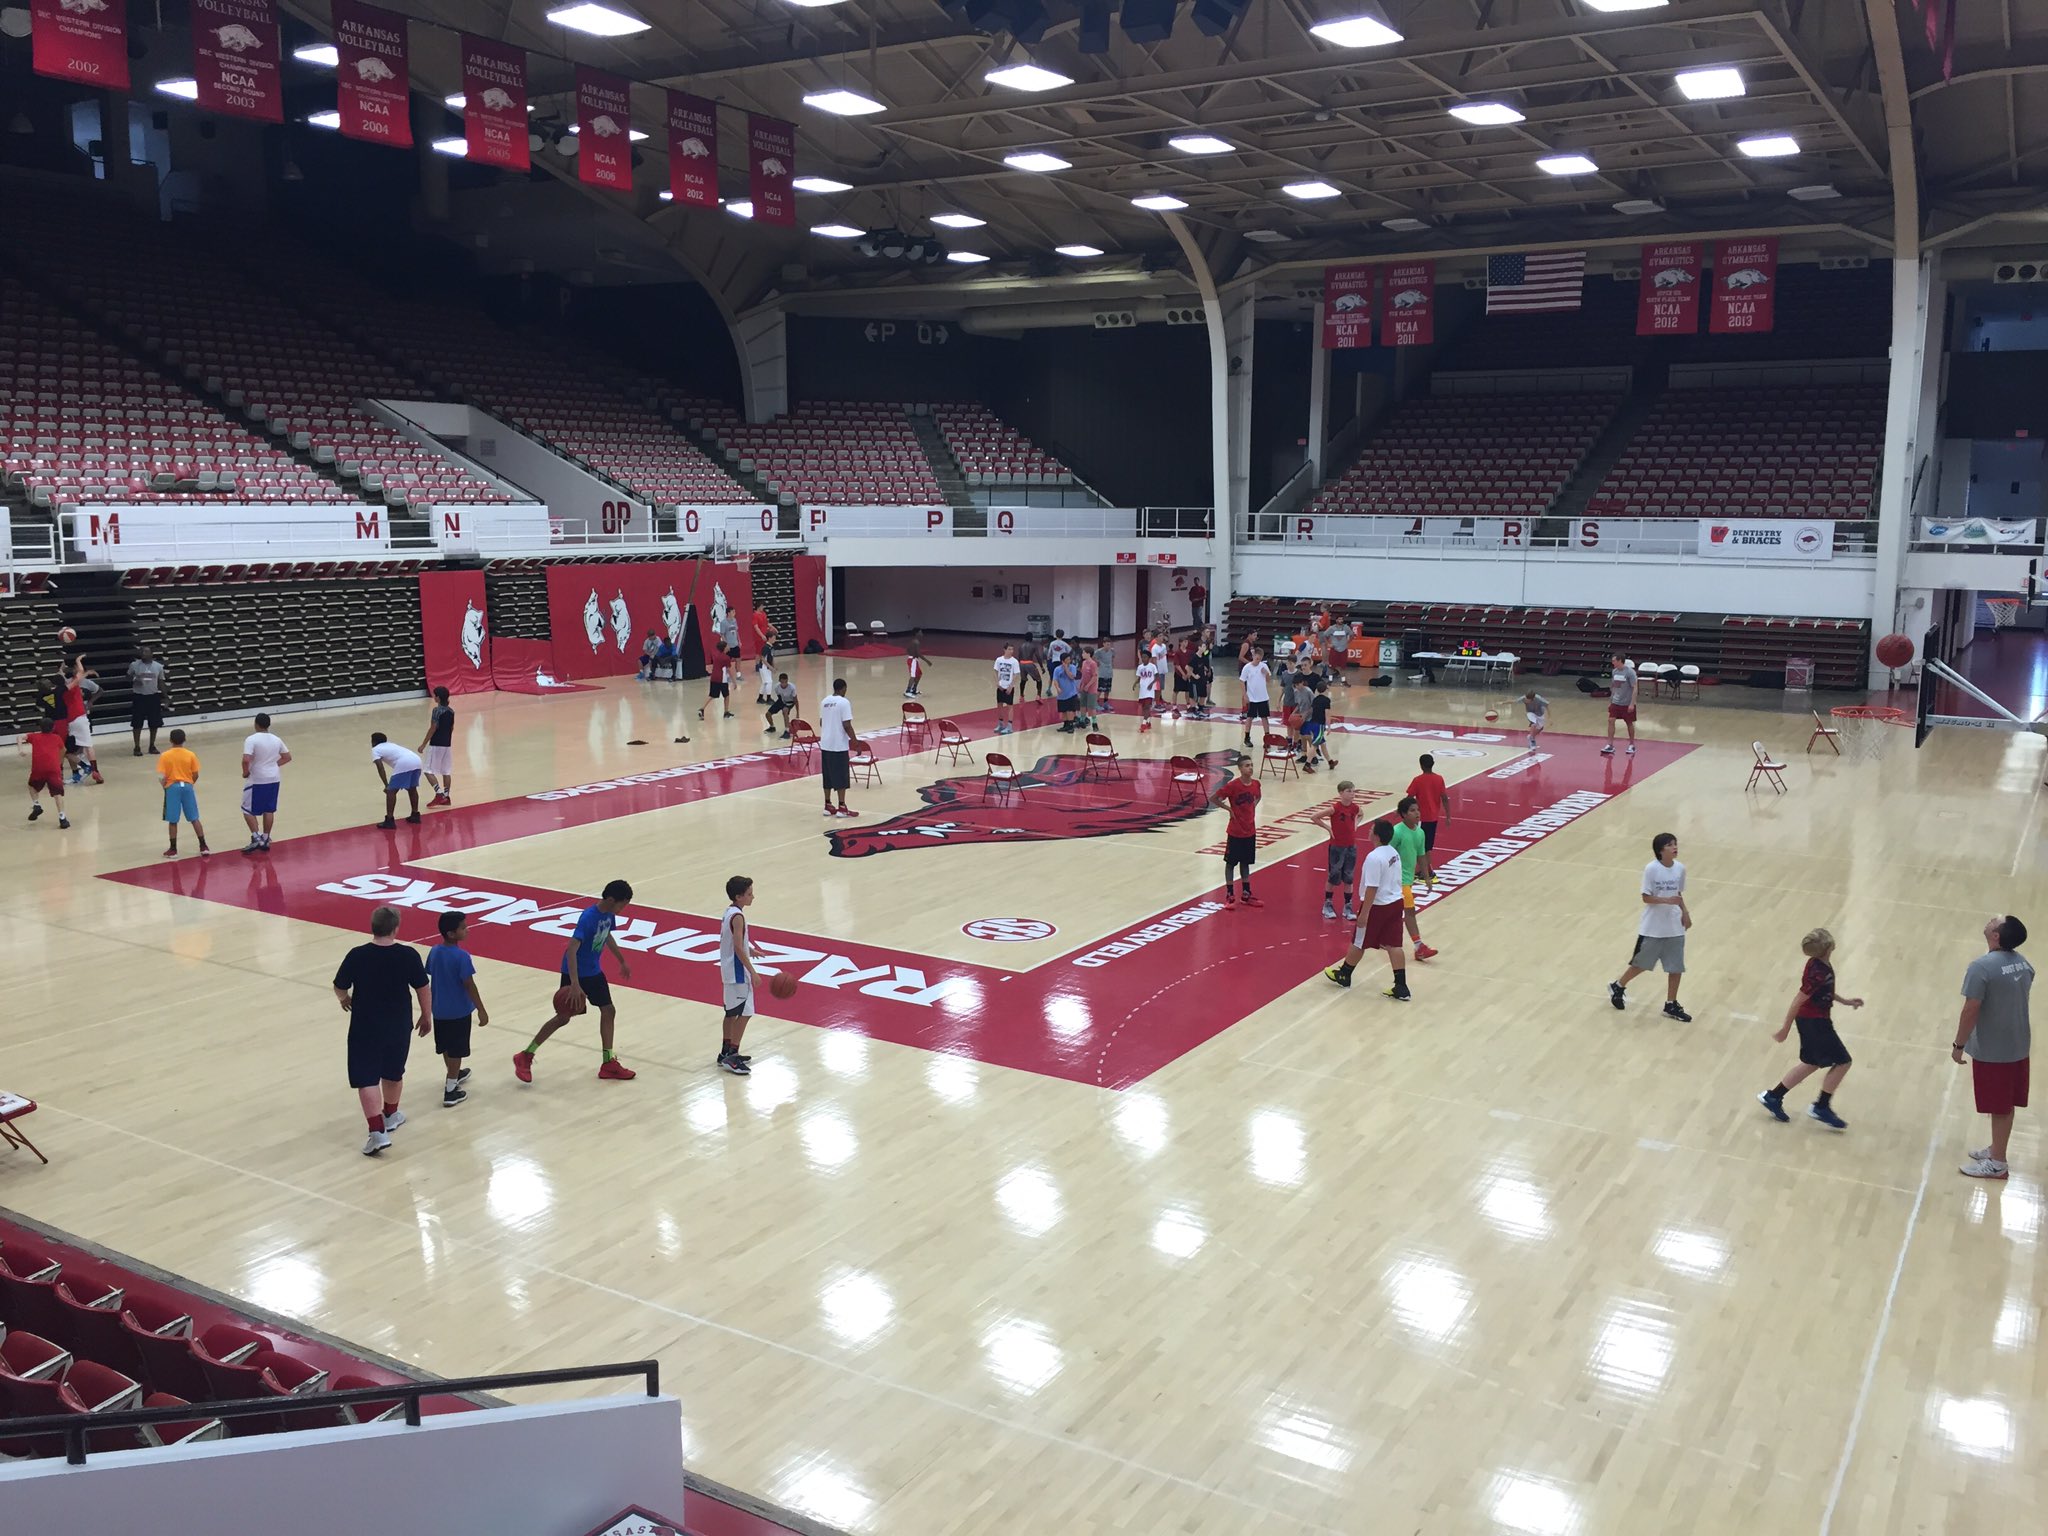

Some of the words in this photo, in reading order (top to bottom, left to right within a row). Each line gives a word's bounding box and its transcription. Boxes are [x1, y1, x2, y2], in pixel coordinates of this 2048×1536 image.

[198, 0, 273, 24] VOLLEYBALL
[342, 19, 400, 43] ARKANSAS
[338, 31, 404, 57] VOLLEYBALL
[67, 57, 100, 75] 2002
[469, 53, 521, 75] ARKANSAS
[221, 71, 256, 88] NCAA
[466, 64, 524, 88] VOLLEYBALL
[226, 93, 256, 109] 2003
[242, 88, 266, 98] ROUND
[581, 83, 626, 102] ARKANSAS
[359, 100, 390, 116] NCAA
[581, 94, 630, 115] VOLLEYBALL
[673, 106, 712, 125] ARKANSAS
[362, 118, 390, 135] 2004
[484, 127, 511, 142] NCAA
[670, 117, 714, 137] VOLLEYBALL
[752, 139, 792, 157] VOLLEYBALL
[594, 152, 617, 167] NCAA
[684, 173, 705, 185] NCAA
[686, 188, 704, 200] 2012
[764, 191, 782, 202] NCAA
[1654, 246, 1692, 256] ARKANSAS
[1727, 244, 1767, 255] ARKANSAS
[1649, 256, 1695, 267] GYMNASTICS
[1722, 254, 1769, 265] GYMNASTICS
[1393, 266, 1426, 277] ARKANSAS
[1653, 303, 1681, 315] NCAA
[1727, 302, 1756, 314] NCAA
[1395, 321, 1419, 333] NCAA
[1654, 316, 1679, 328] 2012
[1728, 315, 1753, 327] 2013
[881, 323, 896, 342] P
[1336, 324, 1359, 336] NCAA
[1337, 337, 1356, 348] 2011
[1397, 334, 1416, 345] 2011
[355, 512, 380, 540] M
[445, 512, 461, 539] N
[602, 501, 631, 534] OP
[926, 511, 944, 533] P
[997, 511, 1015, 535] Q
[90, 513, 120, 546] M
[1297, 518, 1314, 541] R
[1502, 522, 1522, 546] R
[1580, 522, 1600, 547] S
[1732, 529, 1783, 537] DENTISTRY
[1732, 536, 1740, 545] &
[1741, 537, 1782, 545] BRACES
[526, 753, 770, 801] RAZORBACKS
[1501, 789, 1614, 839] ARKANSAS
[315, 873, 979, 1008] RAZORBACKS
[1071, 901, 1226, 968] #NEVERYIELD
